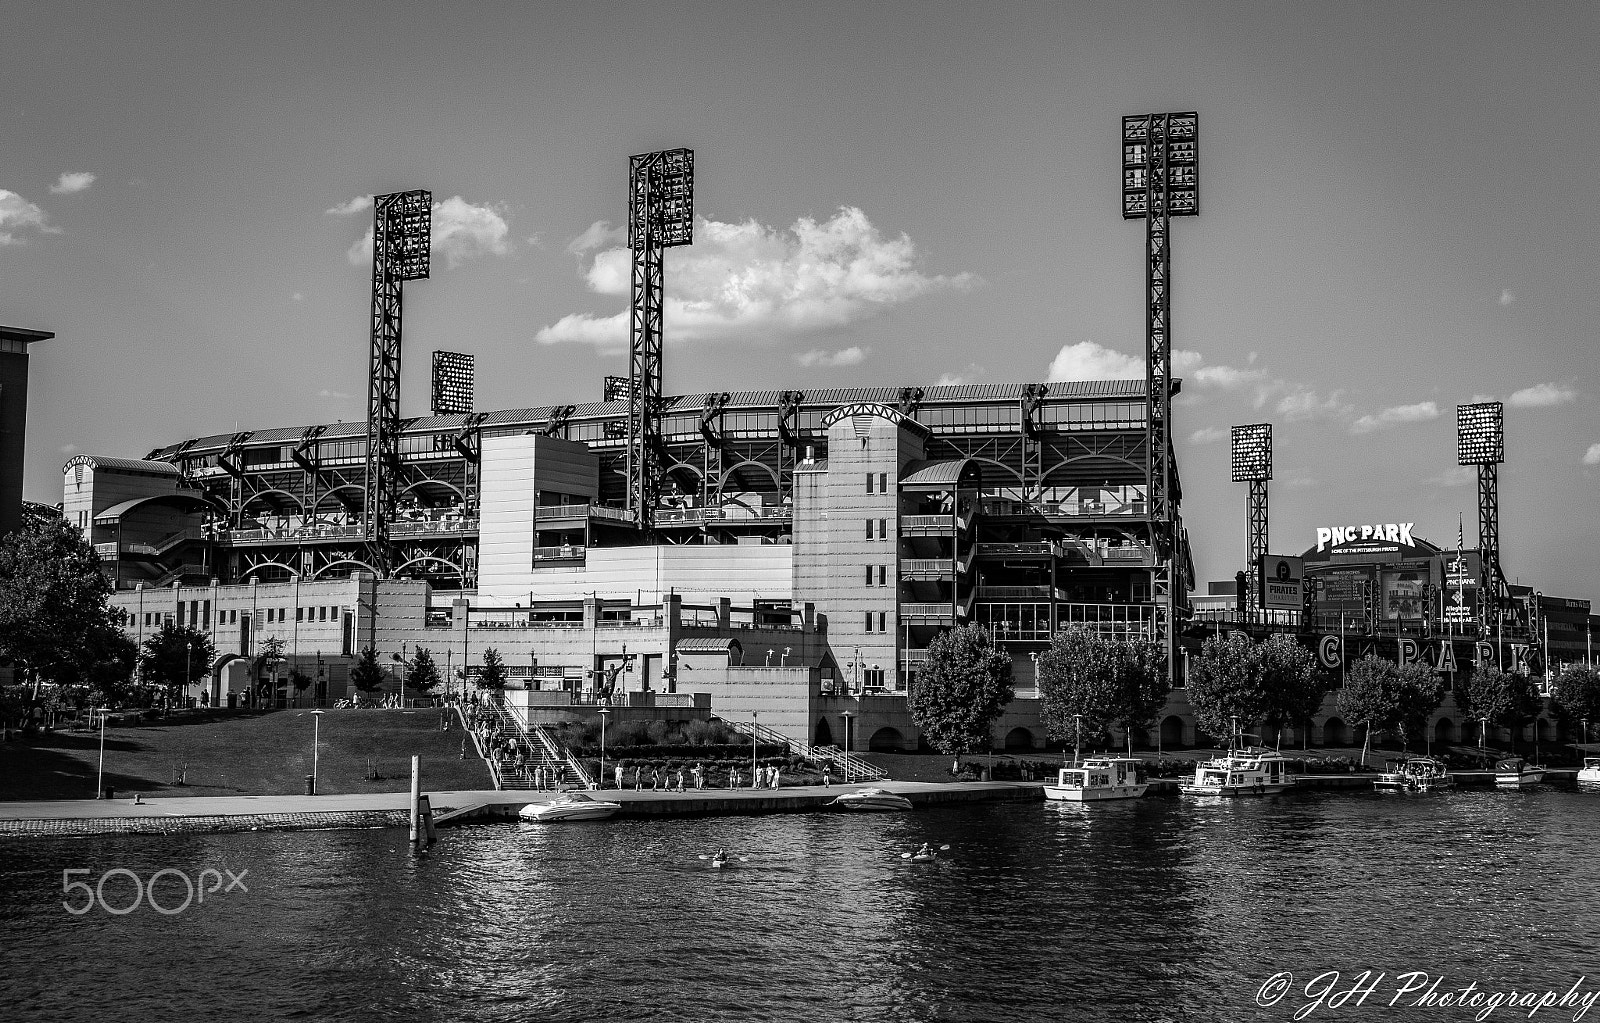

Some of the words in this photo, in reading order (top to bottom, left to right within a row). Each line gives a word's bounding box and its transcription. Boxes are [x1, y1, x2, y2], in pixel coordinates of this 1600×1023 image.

[1316, 526, 1358, 553] PNC
[1361, 522, 1415, 548] PARK
[1280, 566, 1287, 579] P
[1269, 585, 1298, 594] PIRATES
